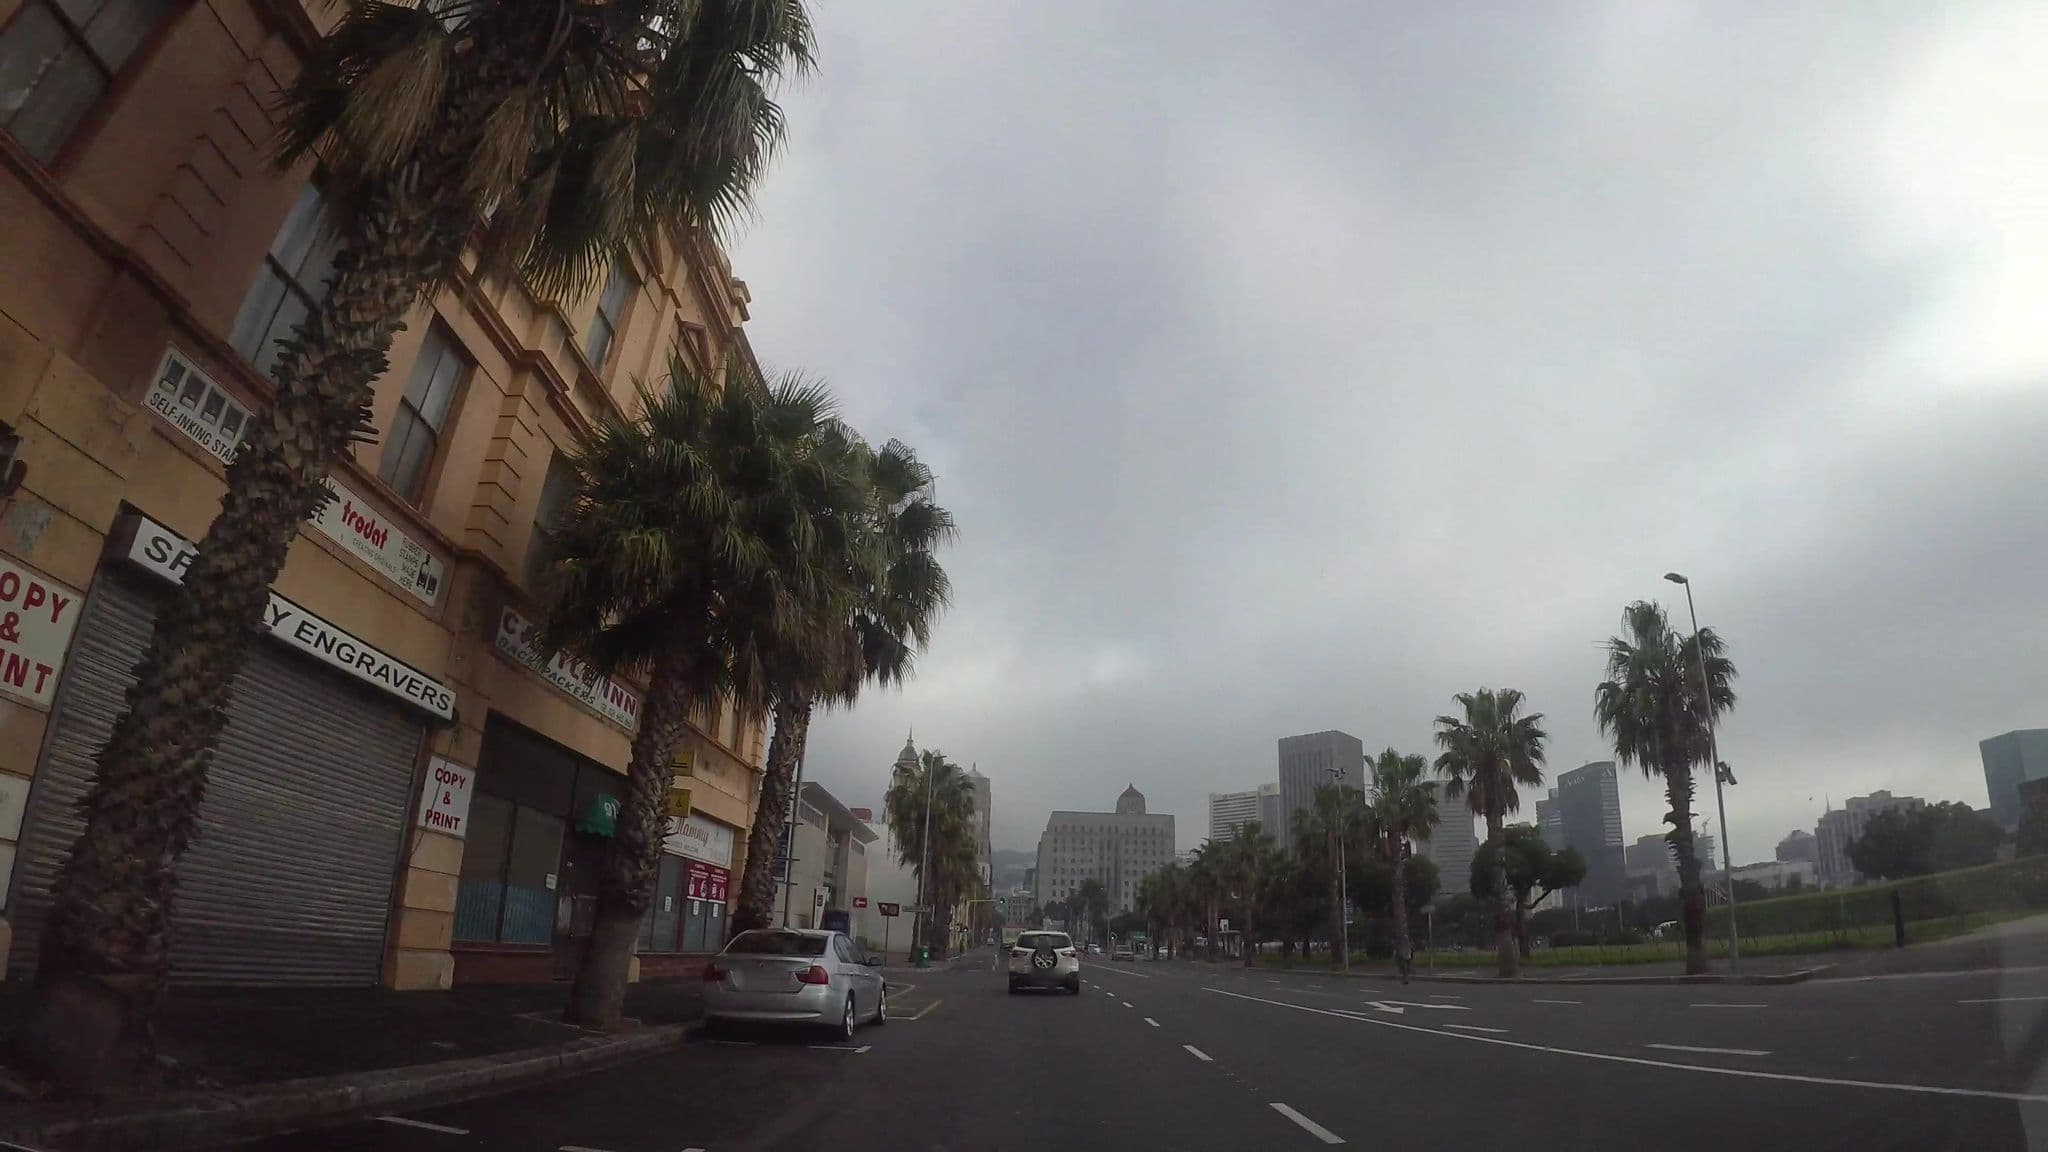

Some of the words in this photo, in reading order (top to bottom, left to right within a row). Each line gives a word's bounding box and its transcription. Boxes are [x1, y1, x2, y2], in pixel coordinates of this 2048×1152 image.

[149, 392, 212, 446] SELF-INKING
[342, 500, 388, 550] trodat
[0, 612, 20, 643] &
[294, 620, 451, 712] ENGRAVERS
[435, 767, 466, 789] COPY
[442, 791, 451, 805] &
[424, 809, 461, 830] PRINT
